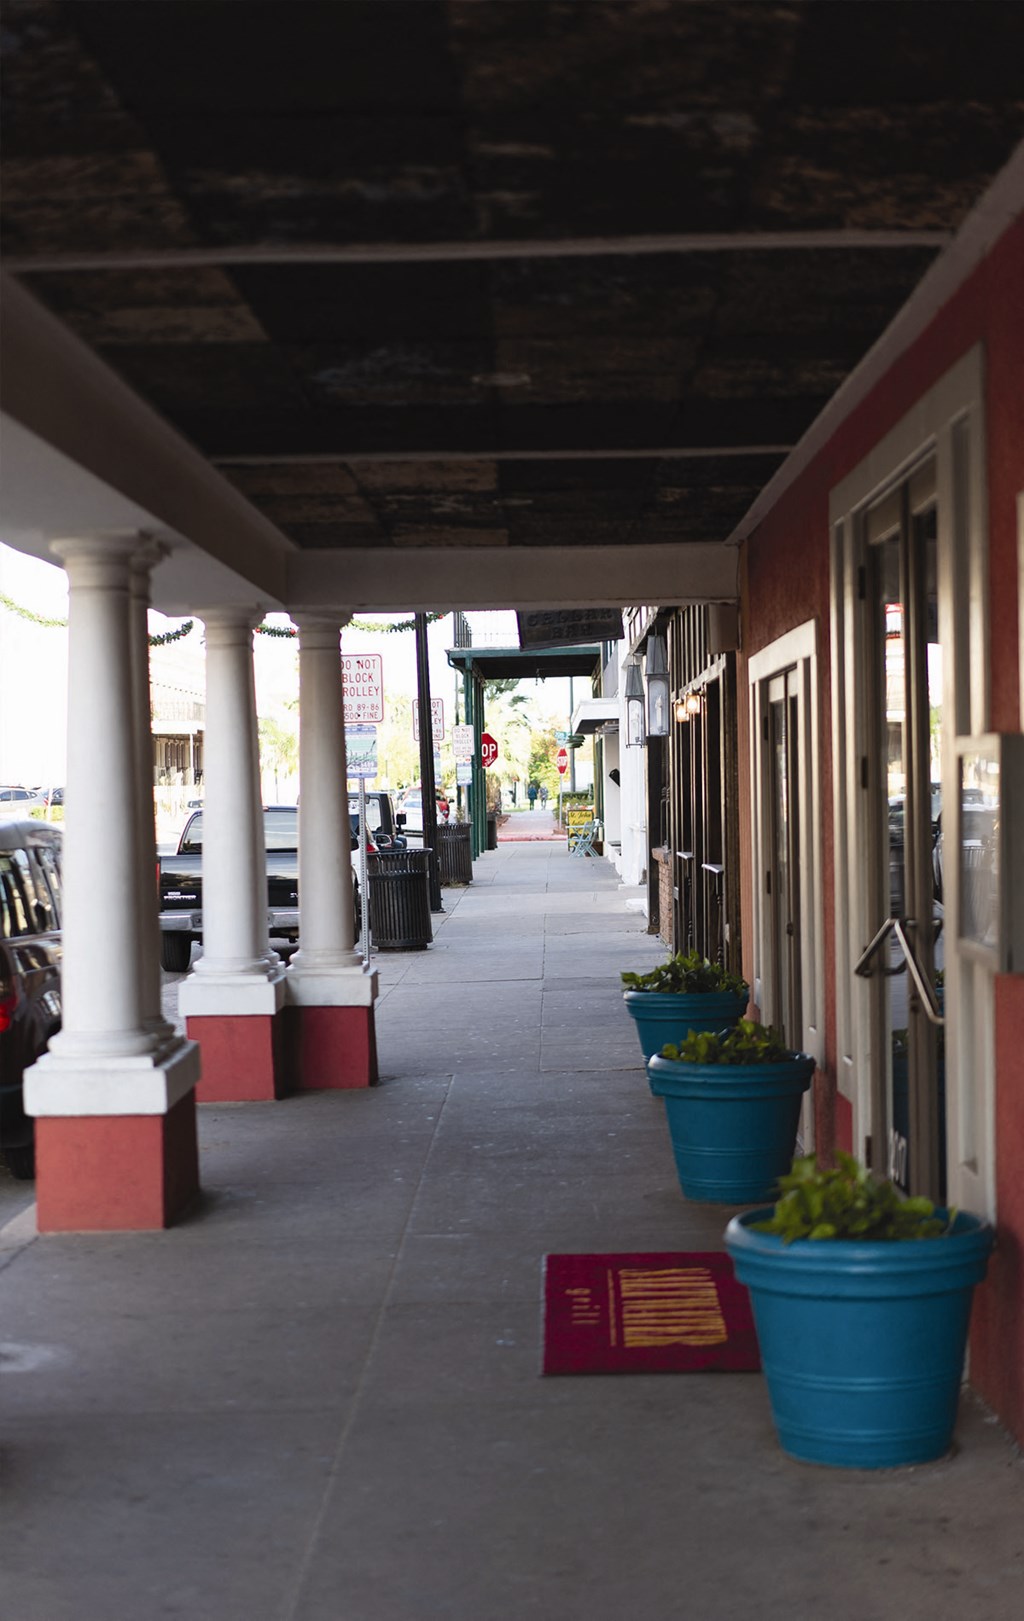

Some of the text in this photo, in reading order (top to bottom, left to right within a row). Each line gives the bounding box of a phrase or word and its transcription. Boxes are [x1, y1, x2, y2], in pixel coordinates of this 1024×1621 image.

[358, 659, 376, 670] NOT
[341, 672, 374, 683] BLOCK
[342, 686, 380, 697] ROLLEY
[356, 703, 380, 711] 89-86
[344, 711, 378, 720] 500 FINE
[481, 743, 497, 757] OP
[557, 756, 568, 766] STOP
[564, 1287, 601, 1325] grill
[618, 1267, 728, 1348] SALTWATER
